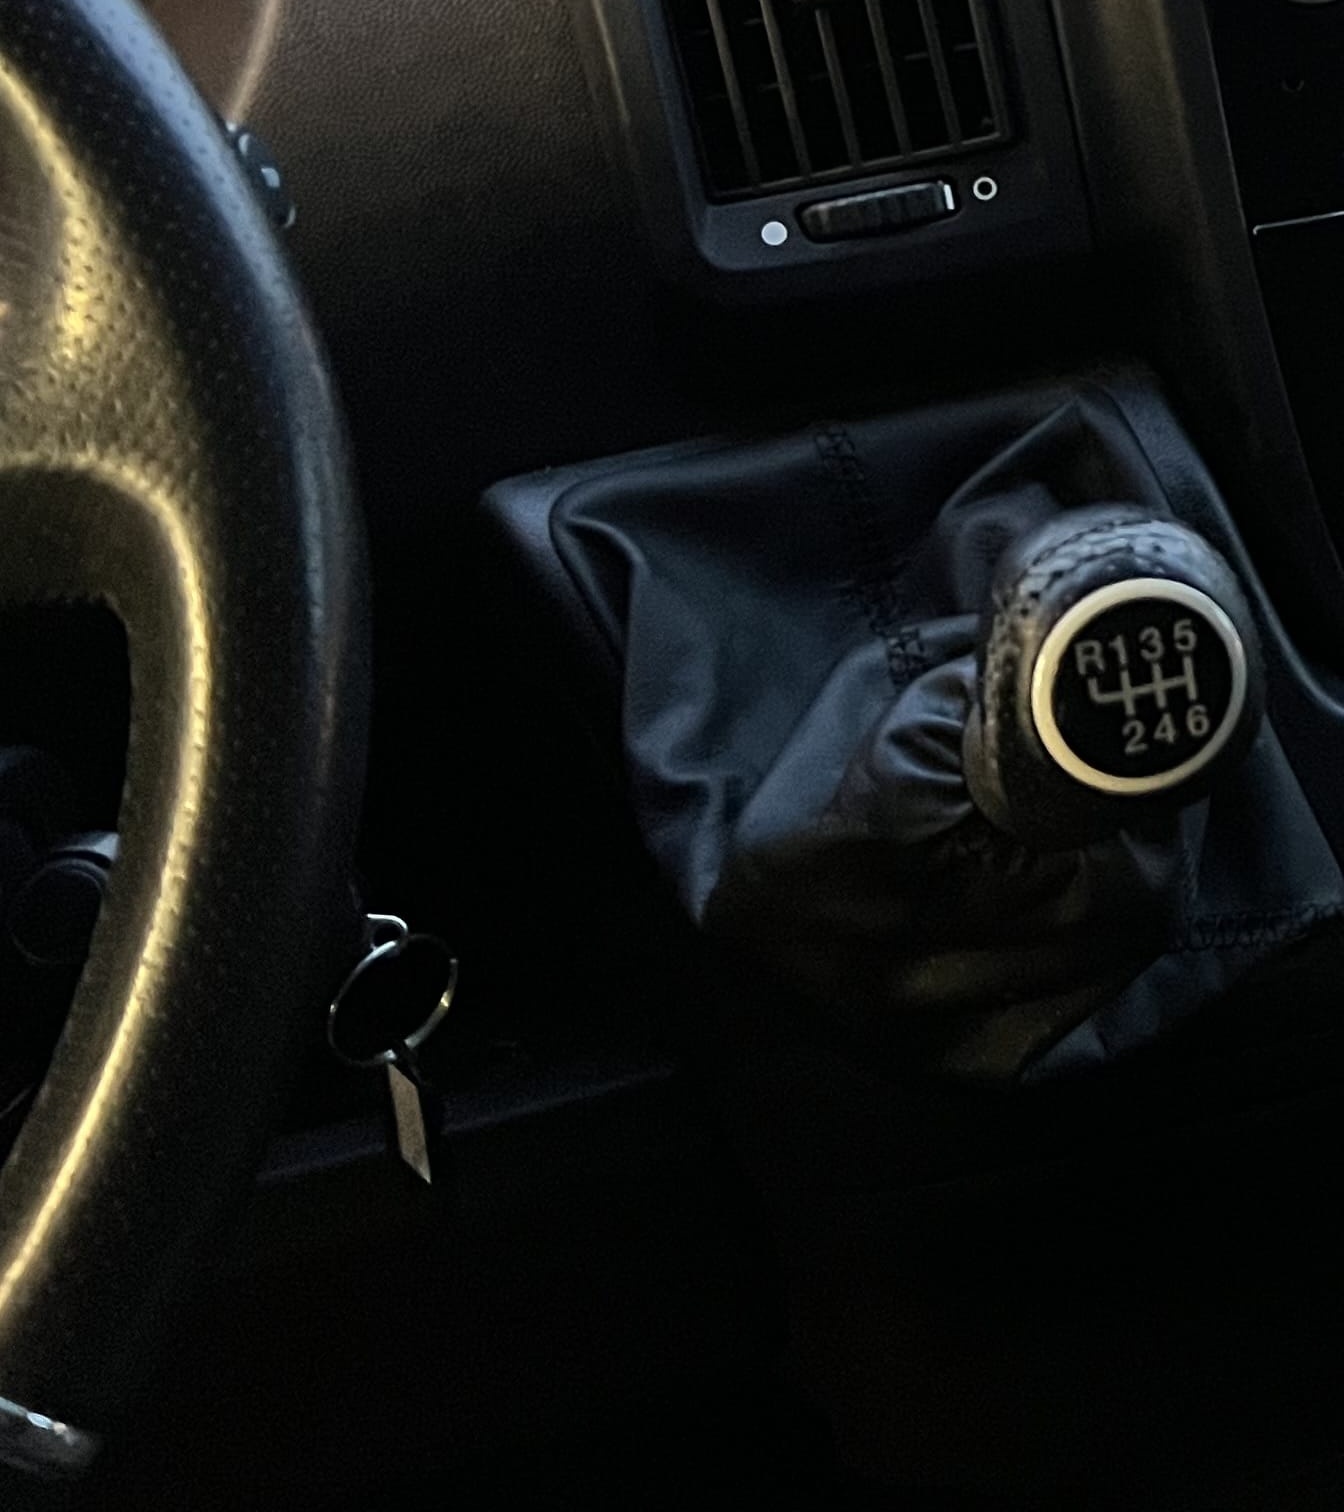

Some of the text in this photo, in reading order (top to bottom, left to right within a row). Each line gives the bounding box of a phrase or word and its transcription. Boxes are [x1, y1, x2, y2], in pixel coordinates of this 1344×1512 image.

[1075, 619, 1197, 676] R 1 3 5
[1122, 705, 1210, 755] 2 4 6
